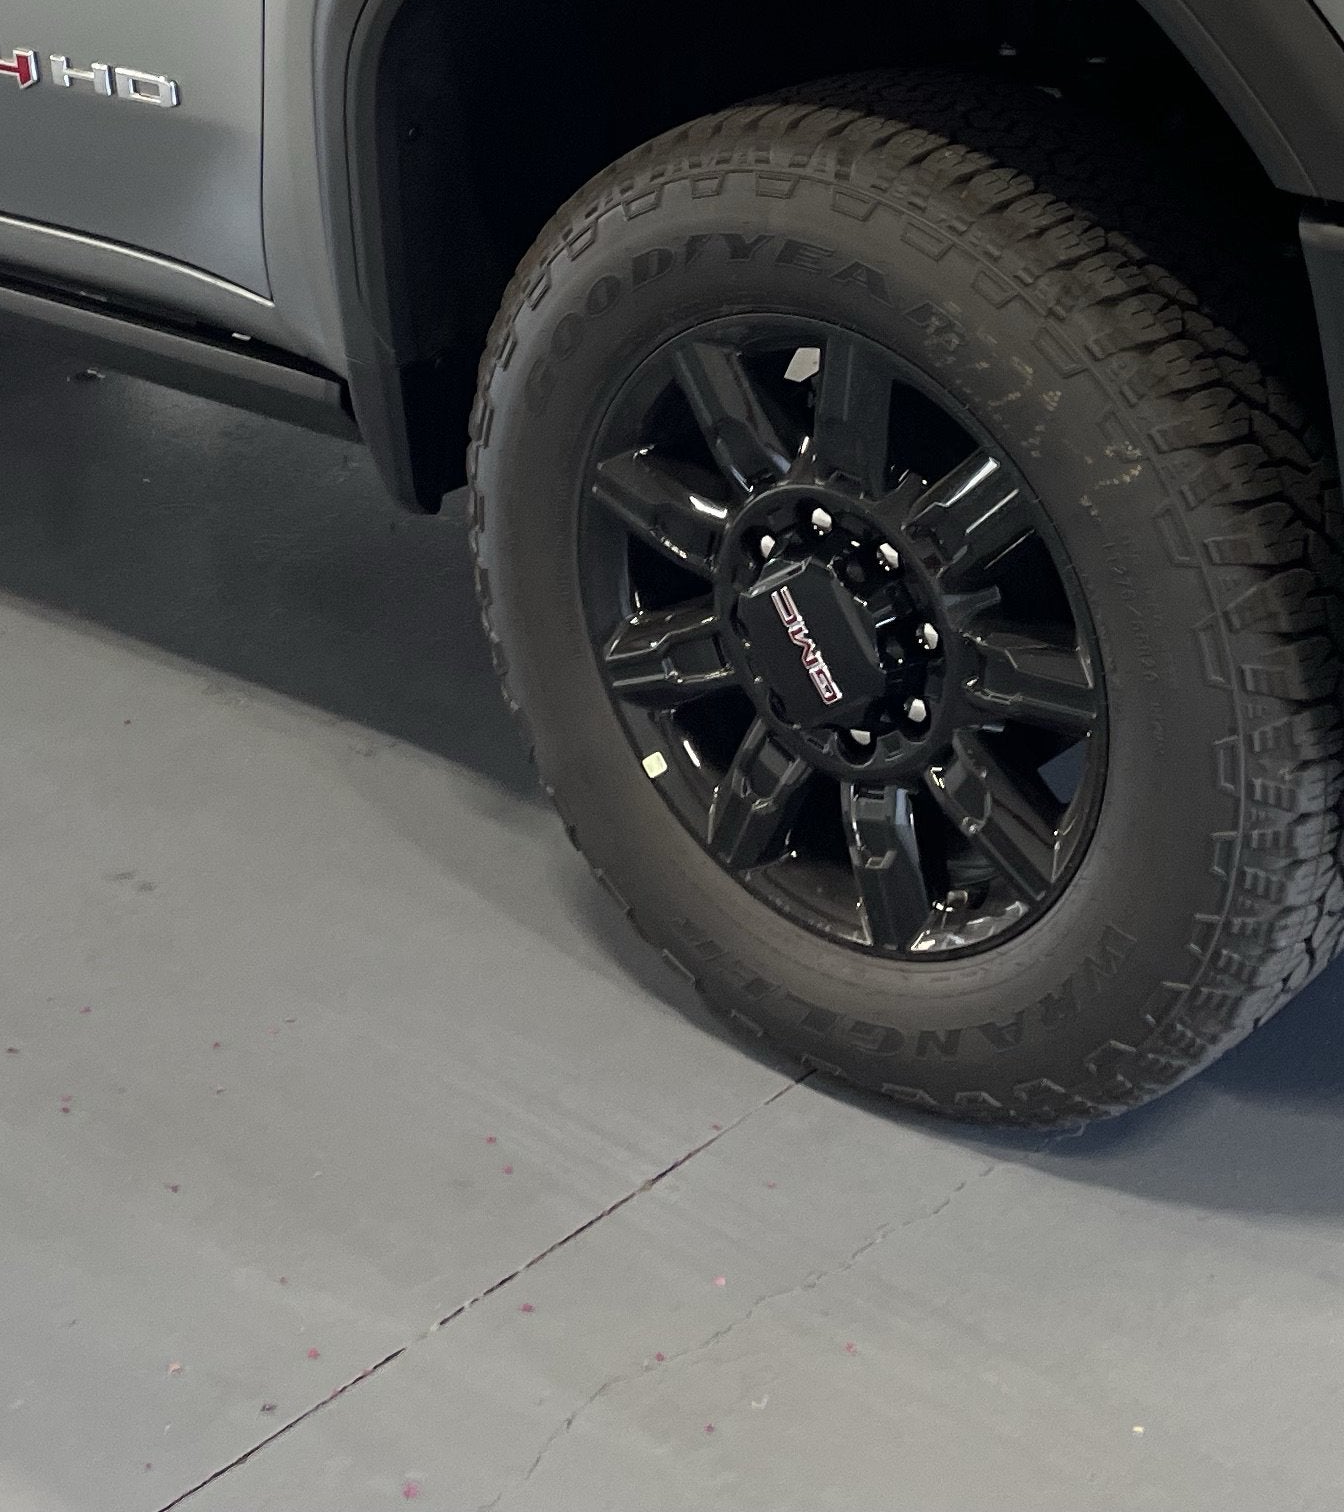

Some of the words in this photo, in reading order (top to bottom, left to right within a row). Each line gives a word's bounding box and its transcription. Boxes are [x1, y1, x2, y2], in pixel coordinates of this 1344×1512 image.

[49, 54, 182, 108] HD
[525, 232, 966, 414] GOODYEAR
[770, 585, 843, 706] GMC
[669, 920, 1137, 1059] WRANGLER
